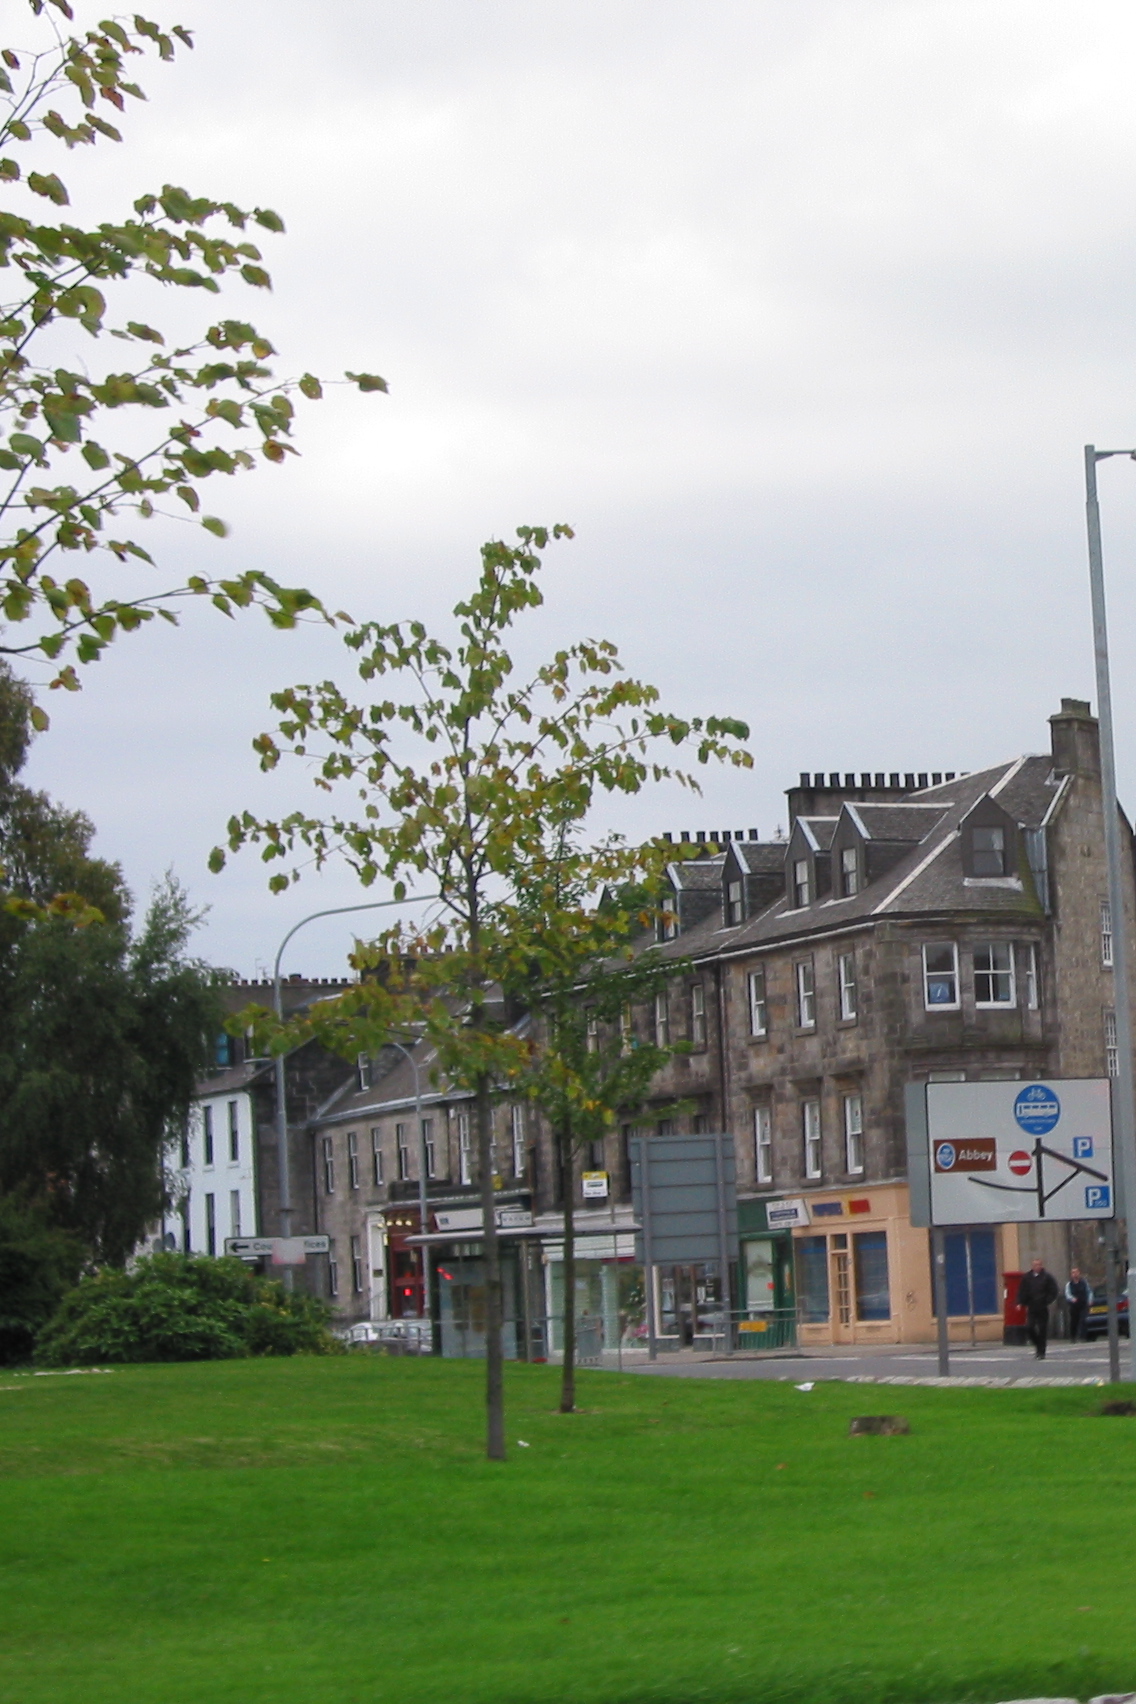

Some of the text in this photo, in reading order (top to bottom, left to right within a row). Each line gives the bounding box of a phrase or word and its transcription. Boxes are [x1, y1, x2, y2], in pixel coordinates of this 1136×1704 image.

[958, 1149, 993, 1162] Abbey
[1078, 1139, 1090, 1156] P
[1088, 1187, 1102, 1207] P
